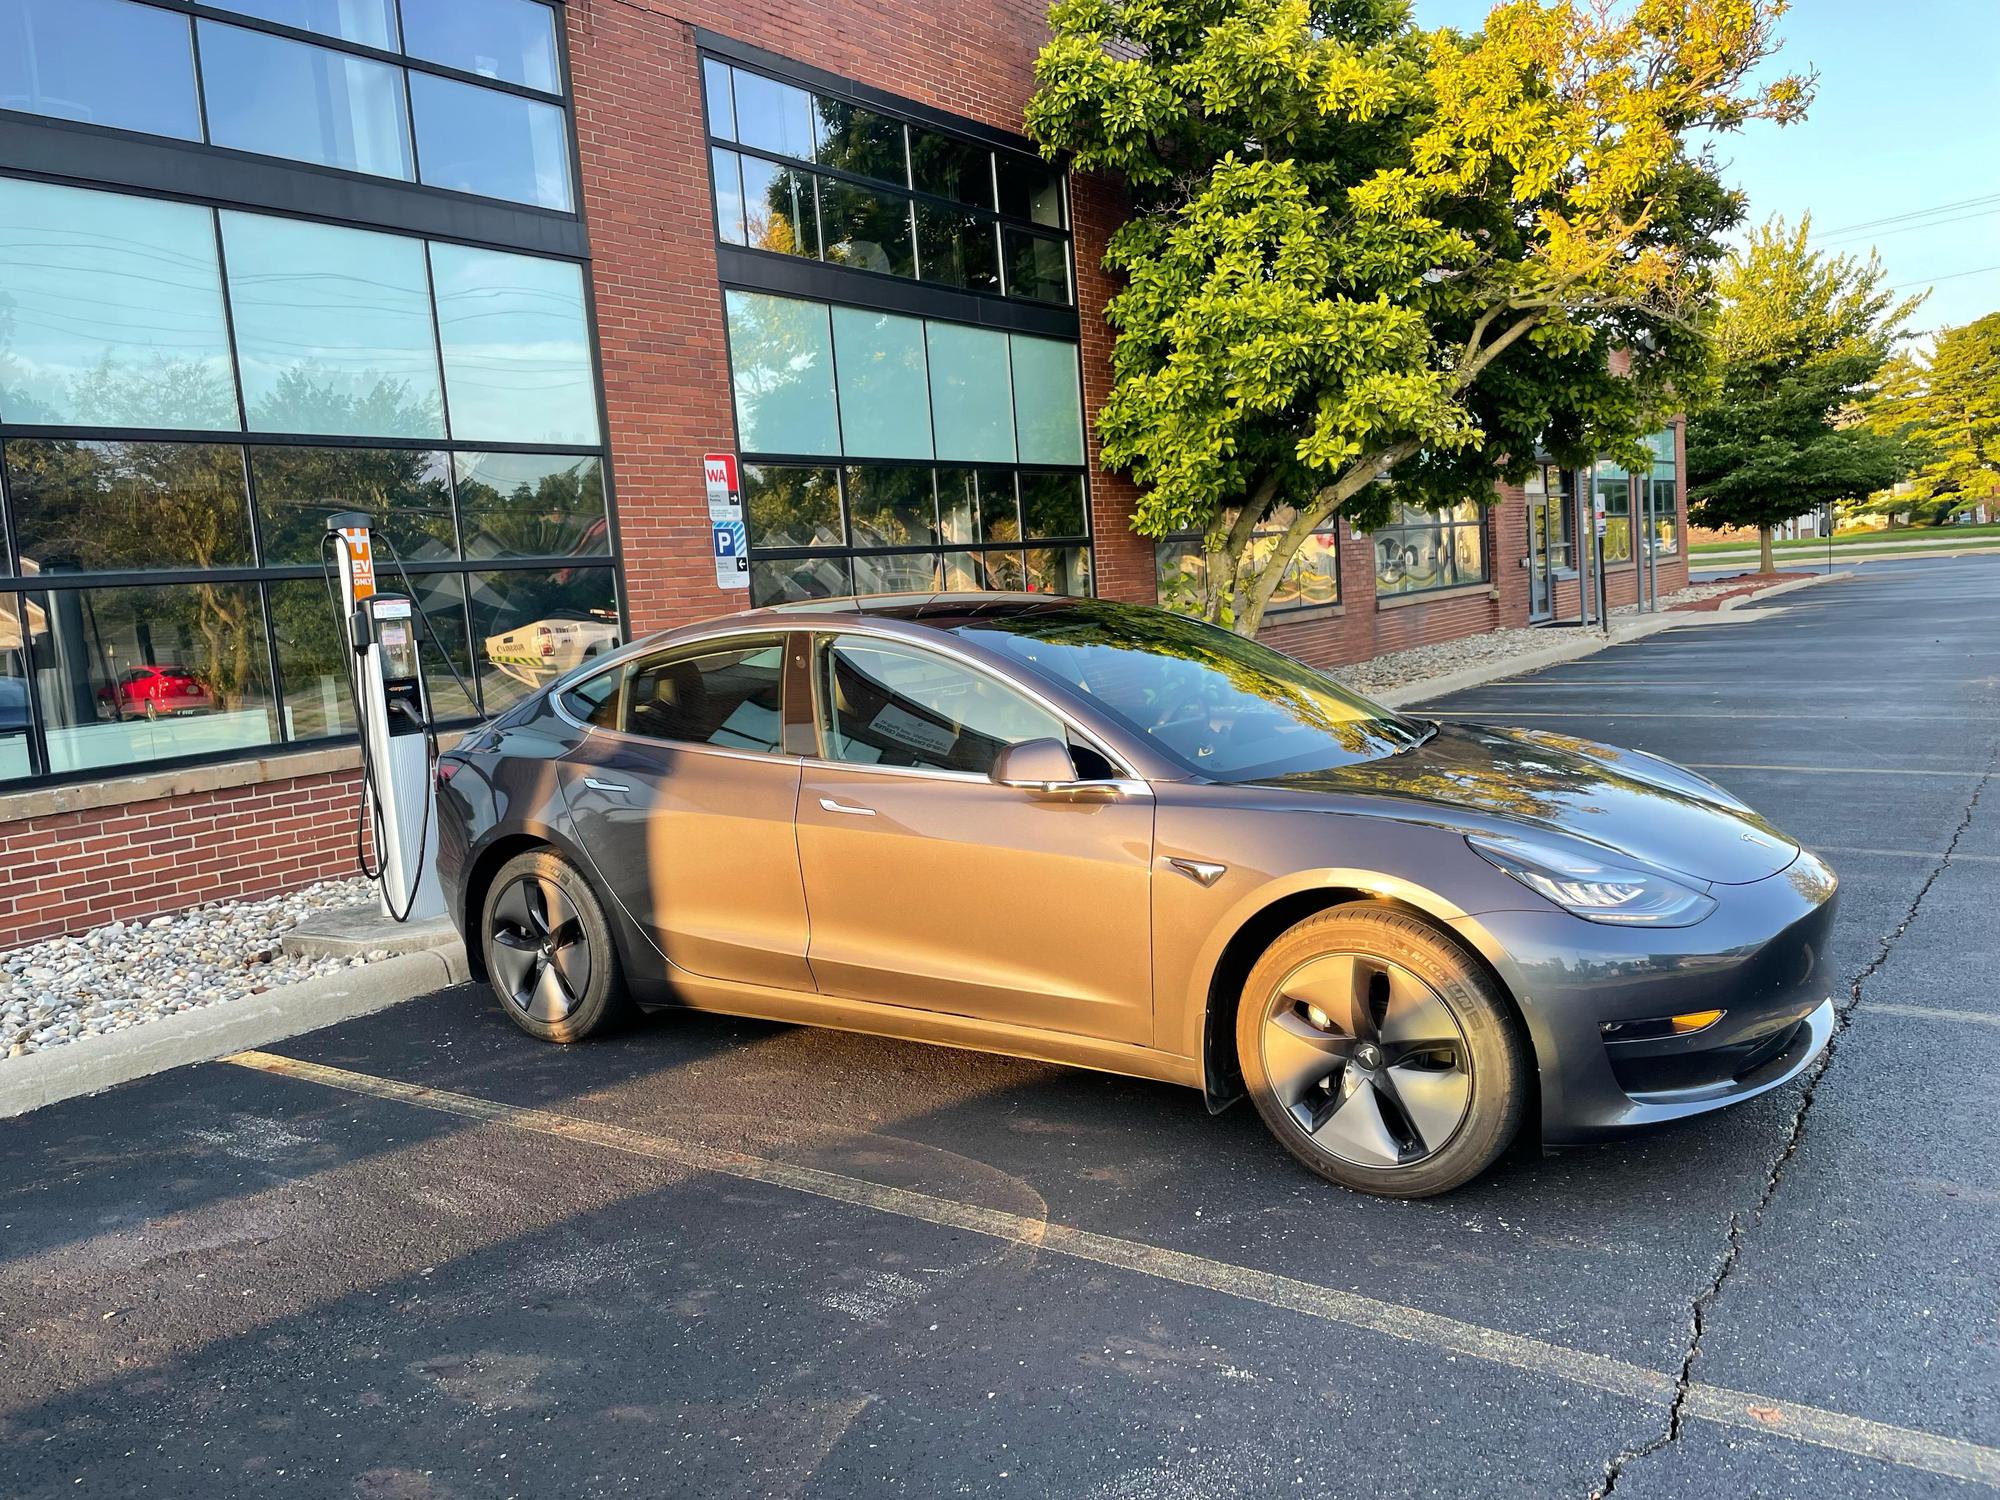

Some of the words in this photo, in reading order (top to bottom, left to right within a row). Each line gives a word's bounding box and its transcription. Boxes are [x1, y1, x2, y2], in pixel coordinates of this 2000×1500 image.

[706, 469, 727, 482] WA
[718, 532, 731, 554] P
[352, 560, 369, 573] EV
[354, 578, 371, 586] ONLY
[1411, 950, 1475, 1013] MICHELIN
